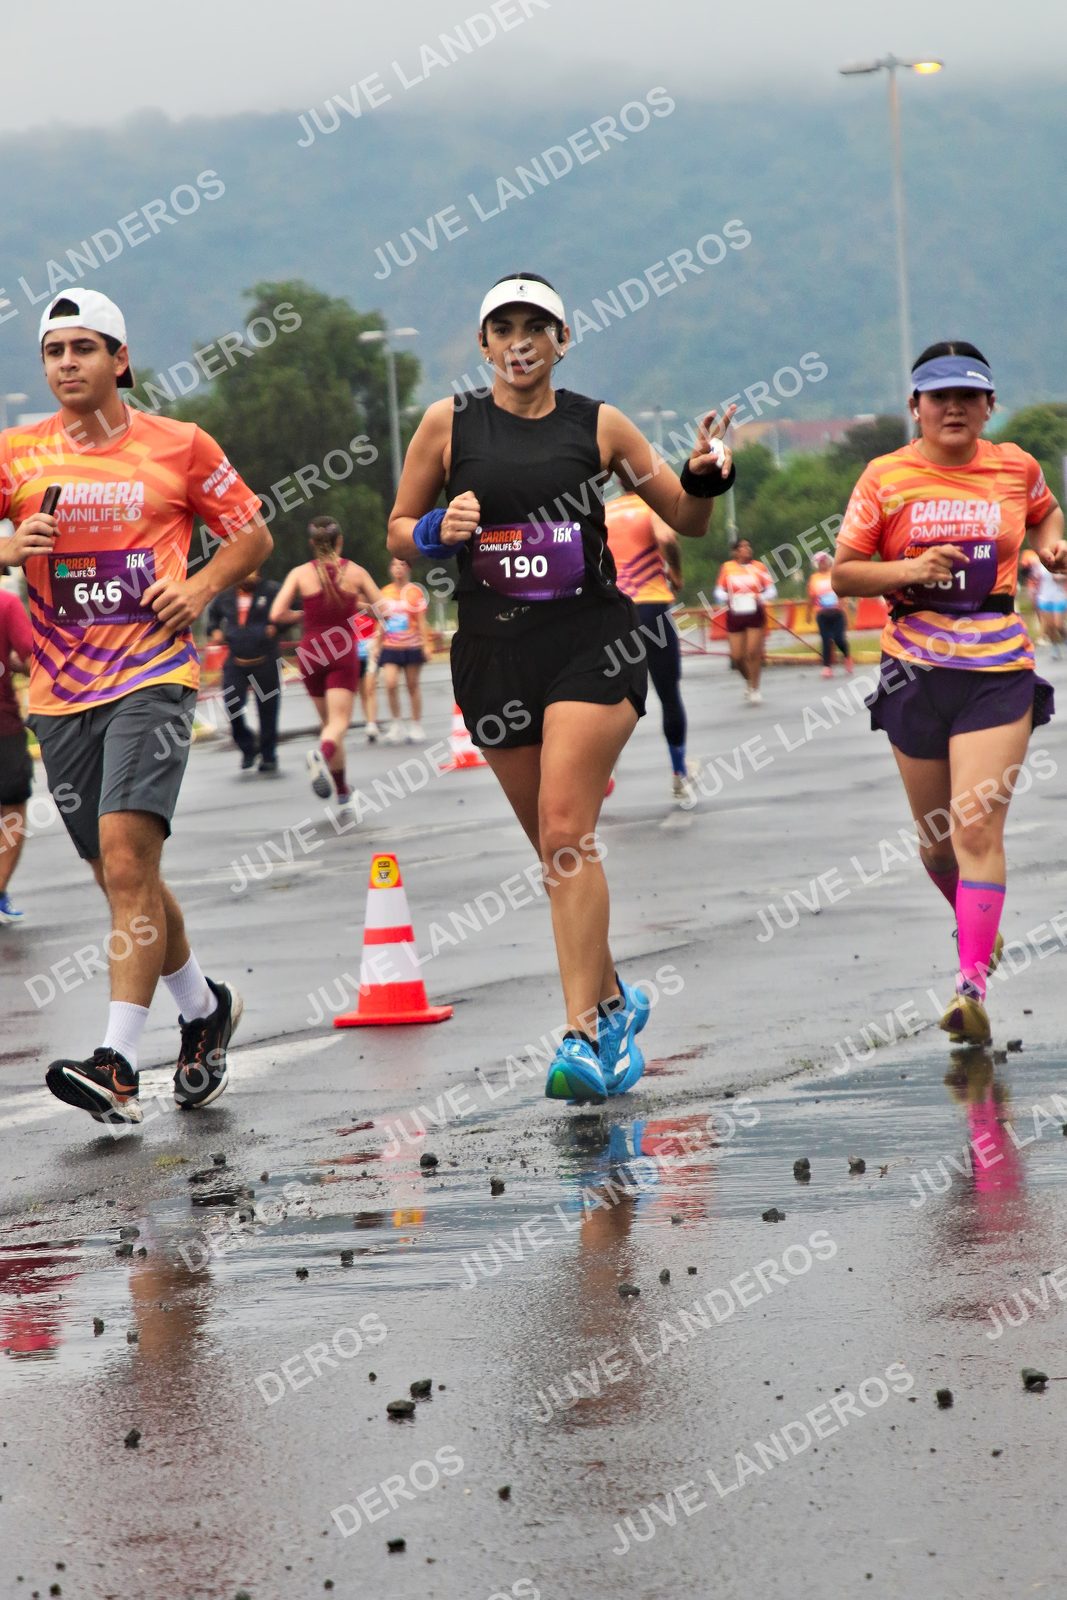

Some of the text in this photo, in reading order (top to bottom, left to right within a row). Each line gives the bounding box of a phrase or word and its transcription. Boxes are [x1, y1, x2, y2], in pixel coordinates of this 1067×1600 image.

[911, 500, 1000, 523] CARRERA
[480, 529, 522, 543] CARRERA
[500, 555, 548, 578] 190
[74, 581, 122, 604] 646
